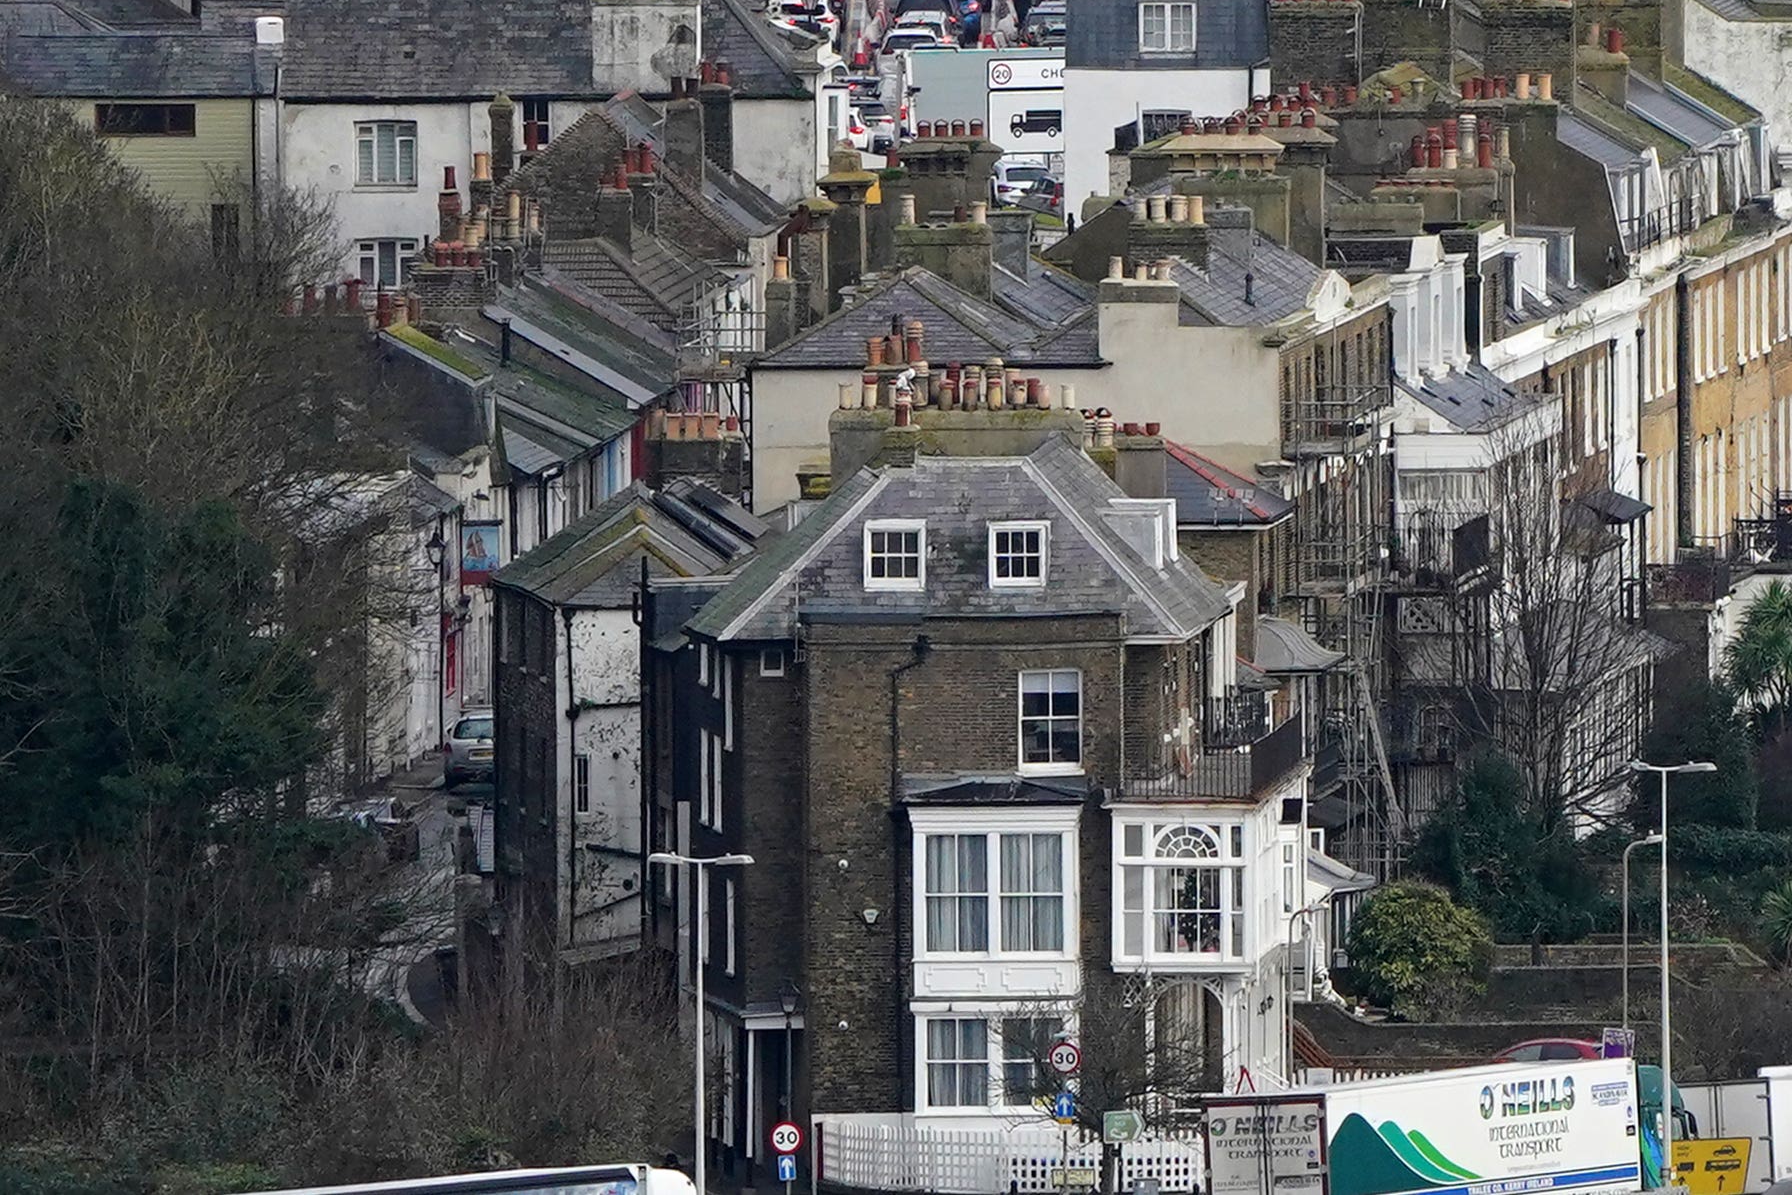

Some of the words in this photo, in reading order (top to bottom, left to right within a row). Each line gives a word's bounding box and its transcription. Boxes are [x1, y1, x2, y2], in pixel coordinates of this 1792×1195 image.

[995, 68, 1009, 79] 20
[1053, 1053, 1076, 1065] 30
[1479, 1075, 1576, 1120] O'NEILLS
[1489, 1116, 1570, 1142] INTERNATIONAL
[774, 1132, 798, 1144] 30
[1499, 1137, 1563, 1160] TRANSPORT
